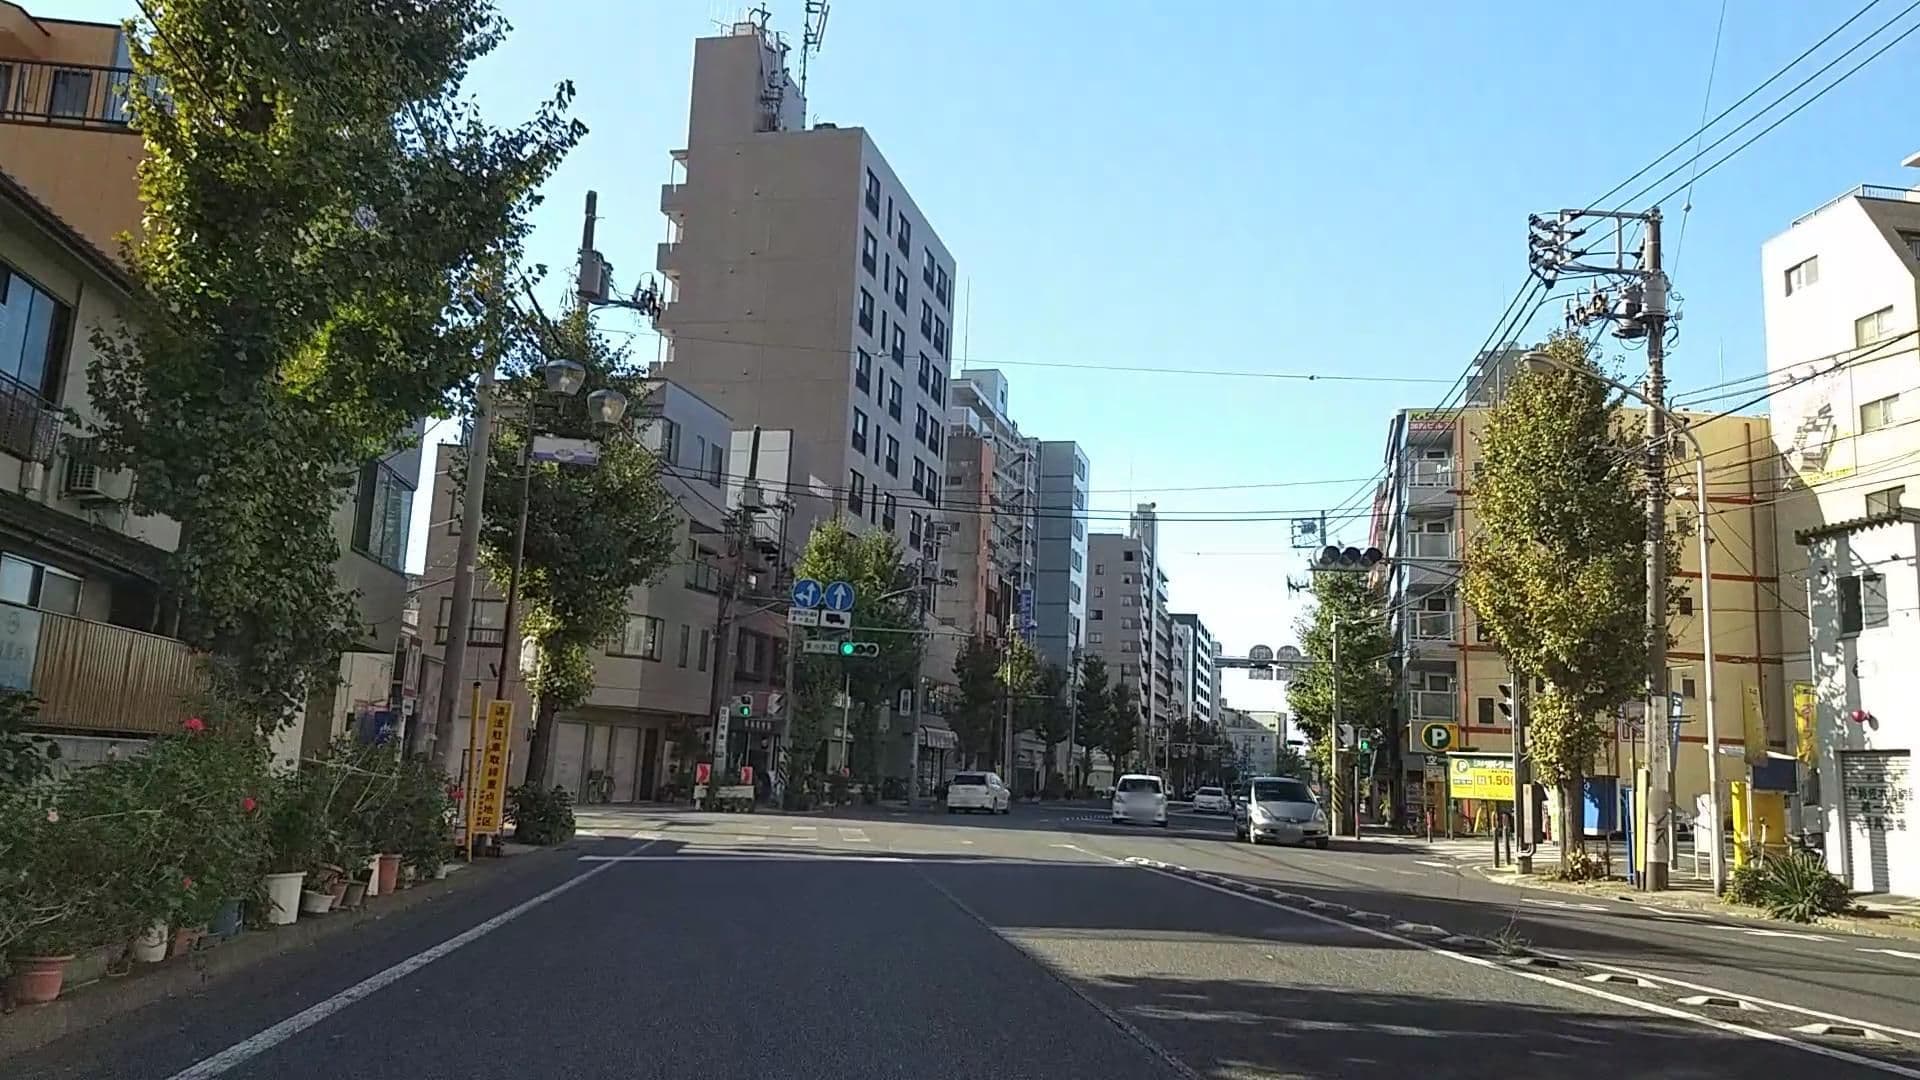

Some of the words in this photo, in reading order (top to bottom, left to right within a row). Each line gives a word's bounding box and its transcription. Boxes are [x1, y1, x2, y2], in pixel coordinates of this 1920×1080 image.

[482, 706, 505, 827] 違法駐車取締重点地区
[1431, 728, 1448, 747] P
